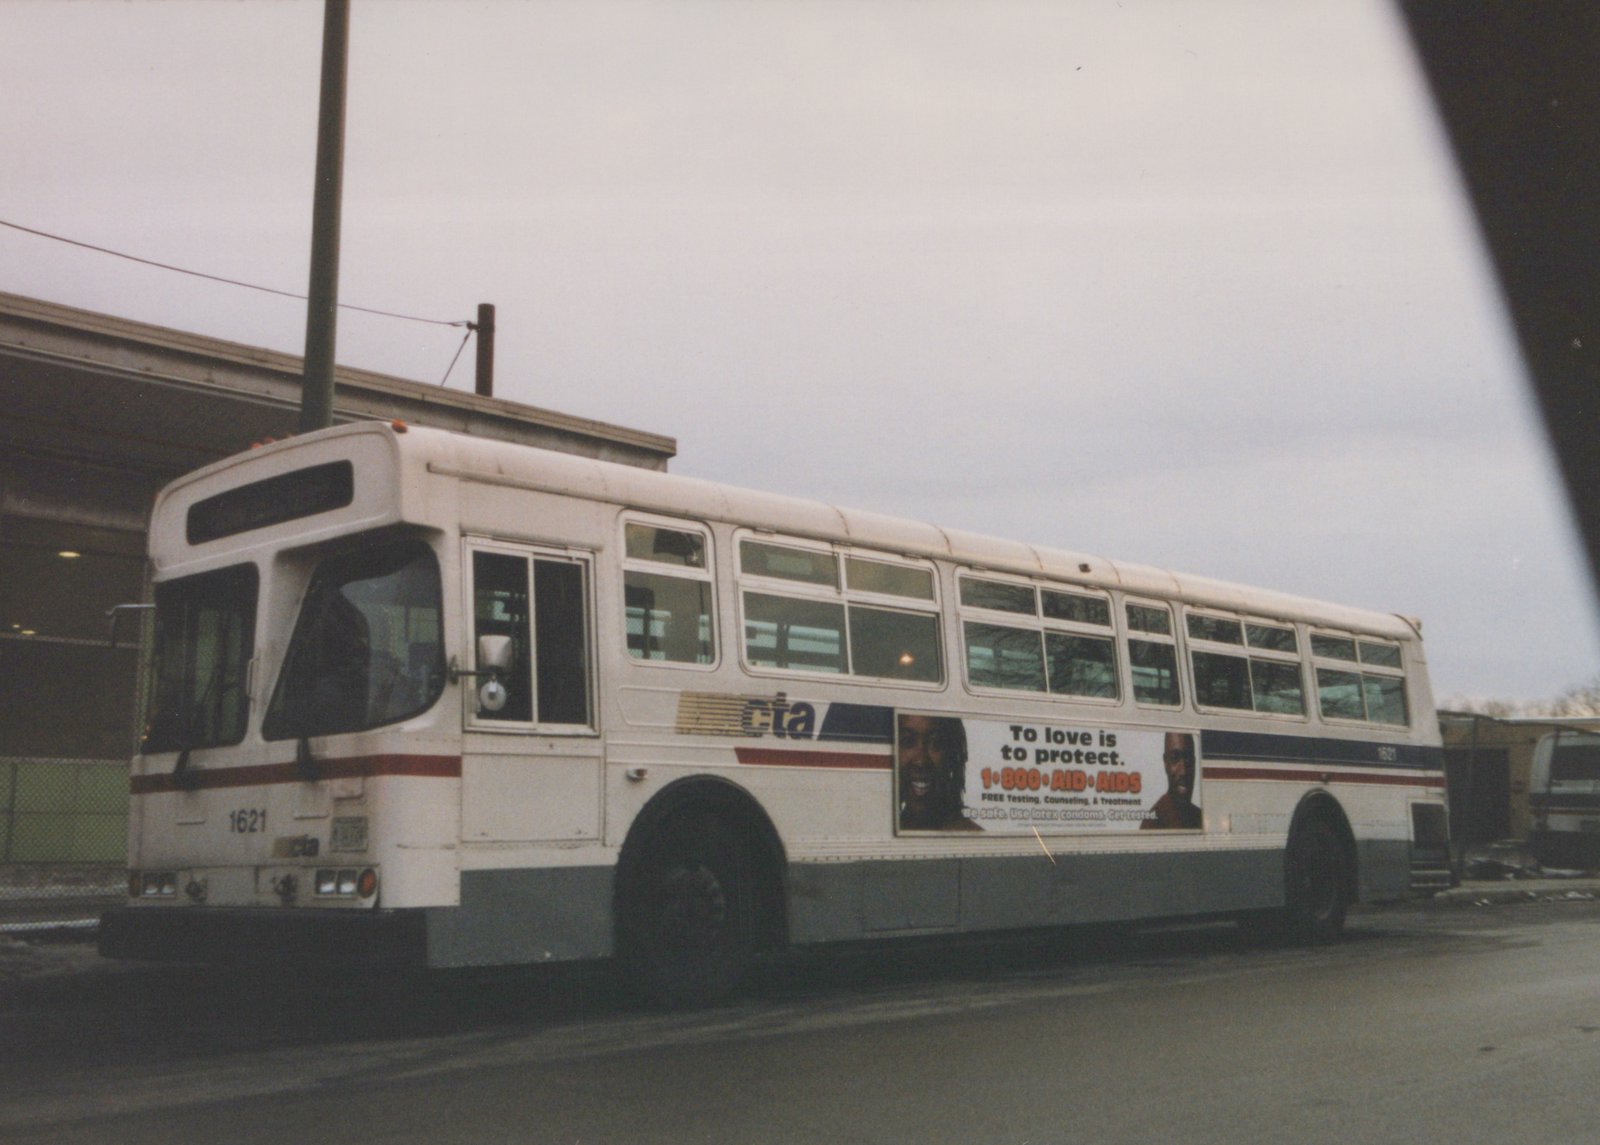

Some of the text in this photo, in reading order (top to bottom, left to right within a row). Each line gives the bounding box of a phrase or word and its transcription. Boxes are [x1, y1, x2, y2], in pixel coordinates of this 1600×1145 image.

[742, 692, 815, 739] cta
[1010, 725, 1117, 748] To love is
[1001, 745, 1125, 766] to protect.
[981, 793, 1005, 803] FREE
[1007, 794, 1042, 806] Testing,
[1093, 797, 1099, 805] &
[1101, 797, 1142, 806] Treatment
[229, 808, 267, 834] 1621
[980, 807, 1008, 820] safe.
[1010, 807, 1030, 820] Use
[1031, 807, 1058, 820] latex
[1107, 808, 1124, 821] Get
[1125, 808, 1159, 821] tested.
